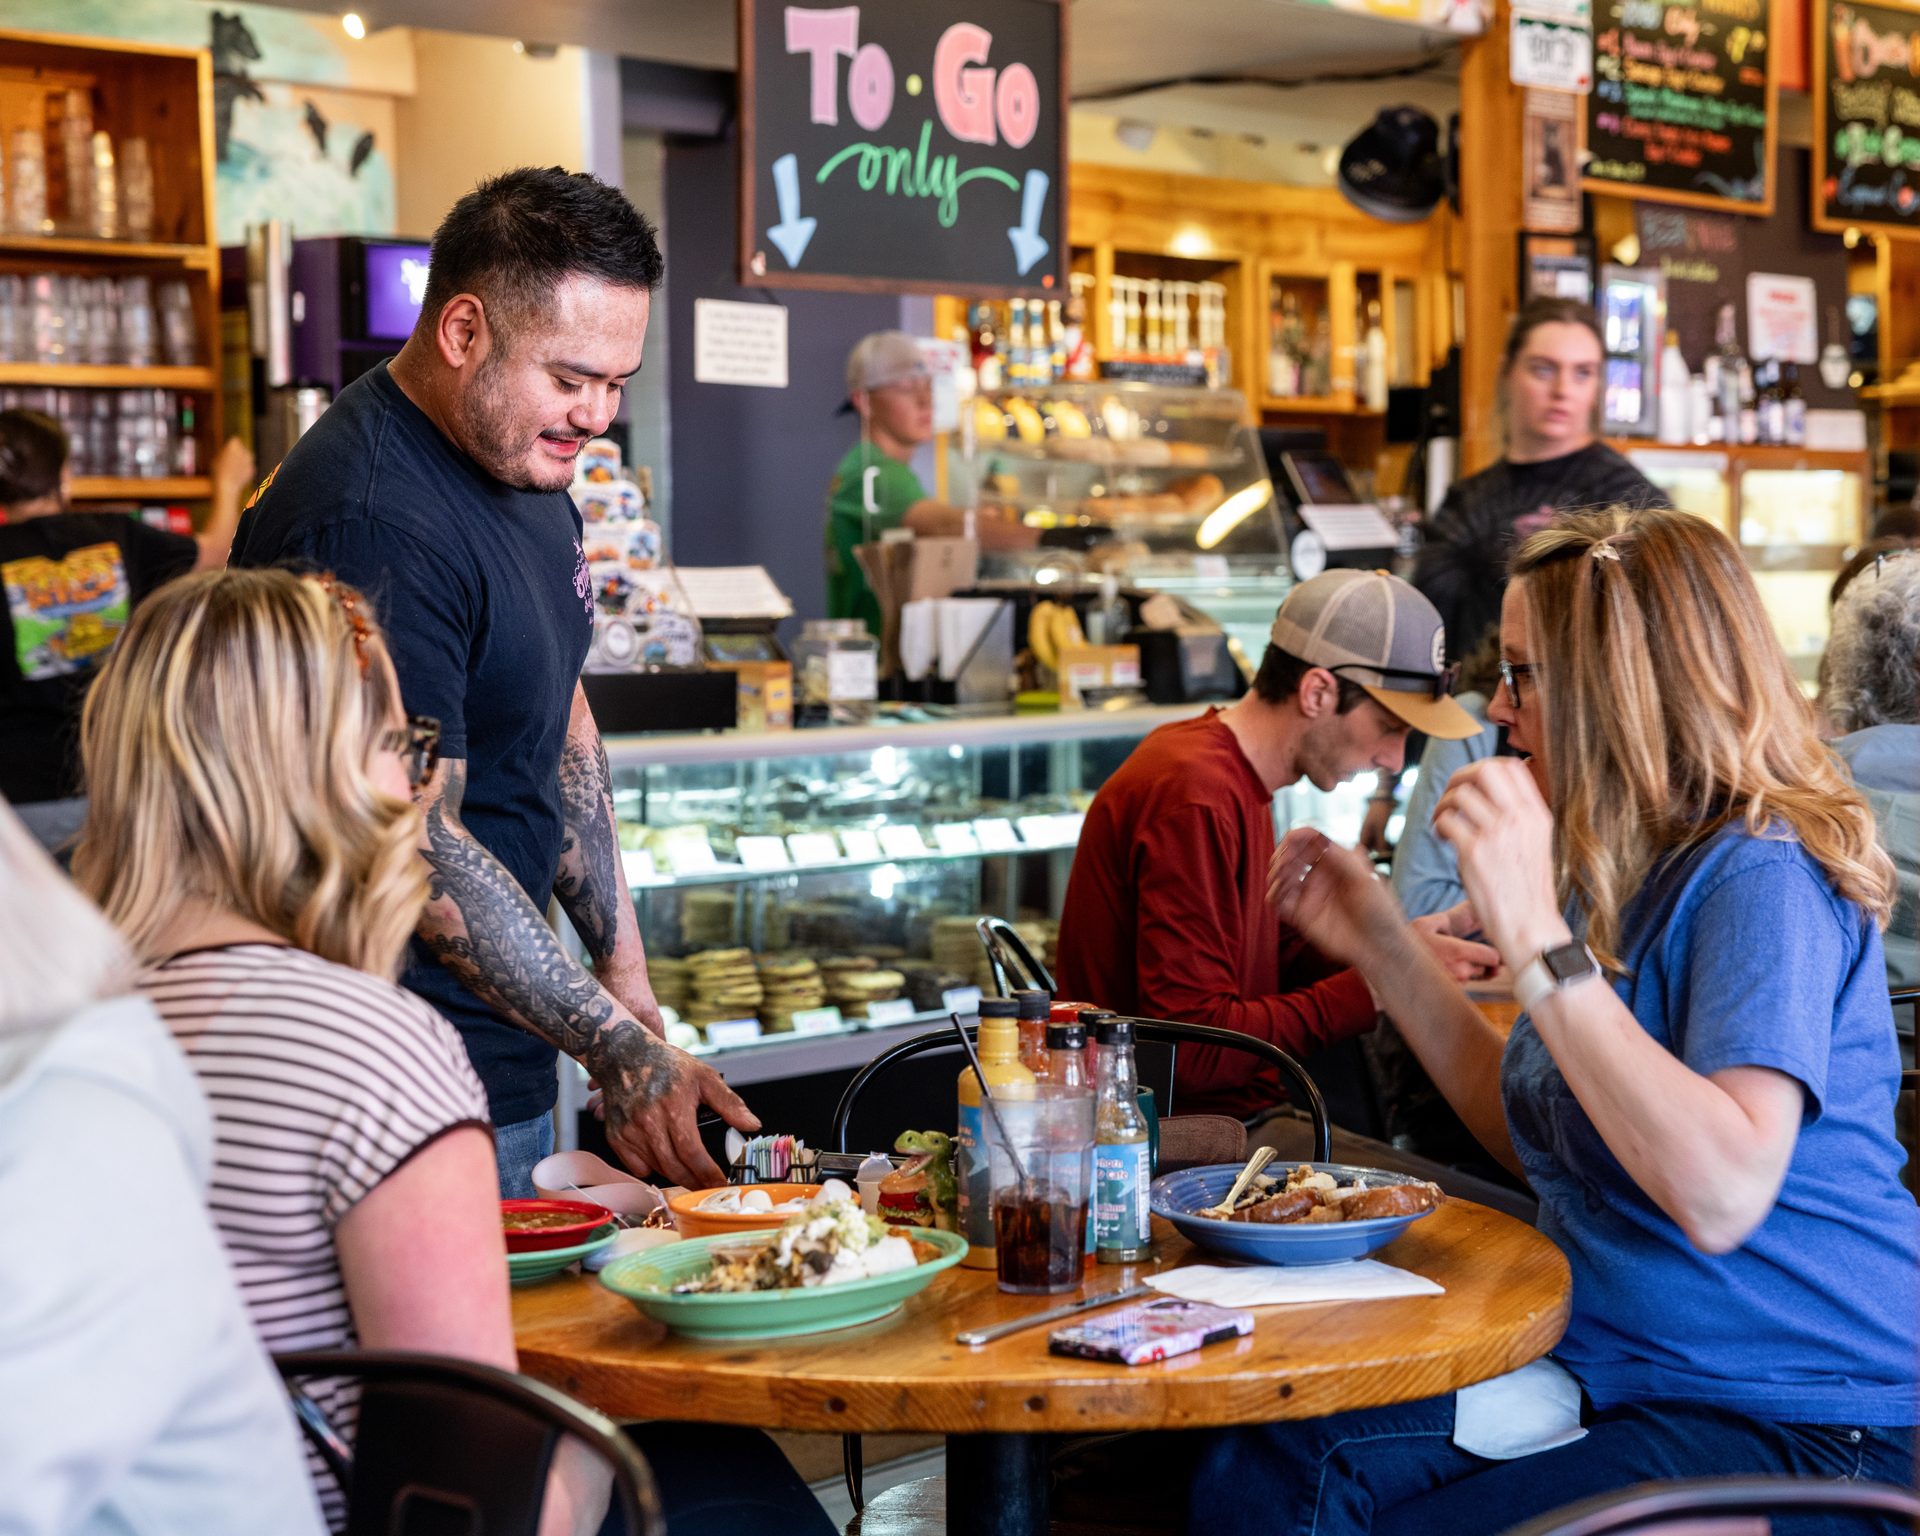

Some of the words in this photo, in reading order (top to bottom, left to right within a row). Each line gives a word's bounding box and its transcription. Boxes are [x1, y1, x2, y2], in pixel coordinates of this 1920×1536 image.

[784, 6, 895, 131] To
[933, 22, 1040, 149] Go
[816, 119, 1020, 228] only
